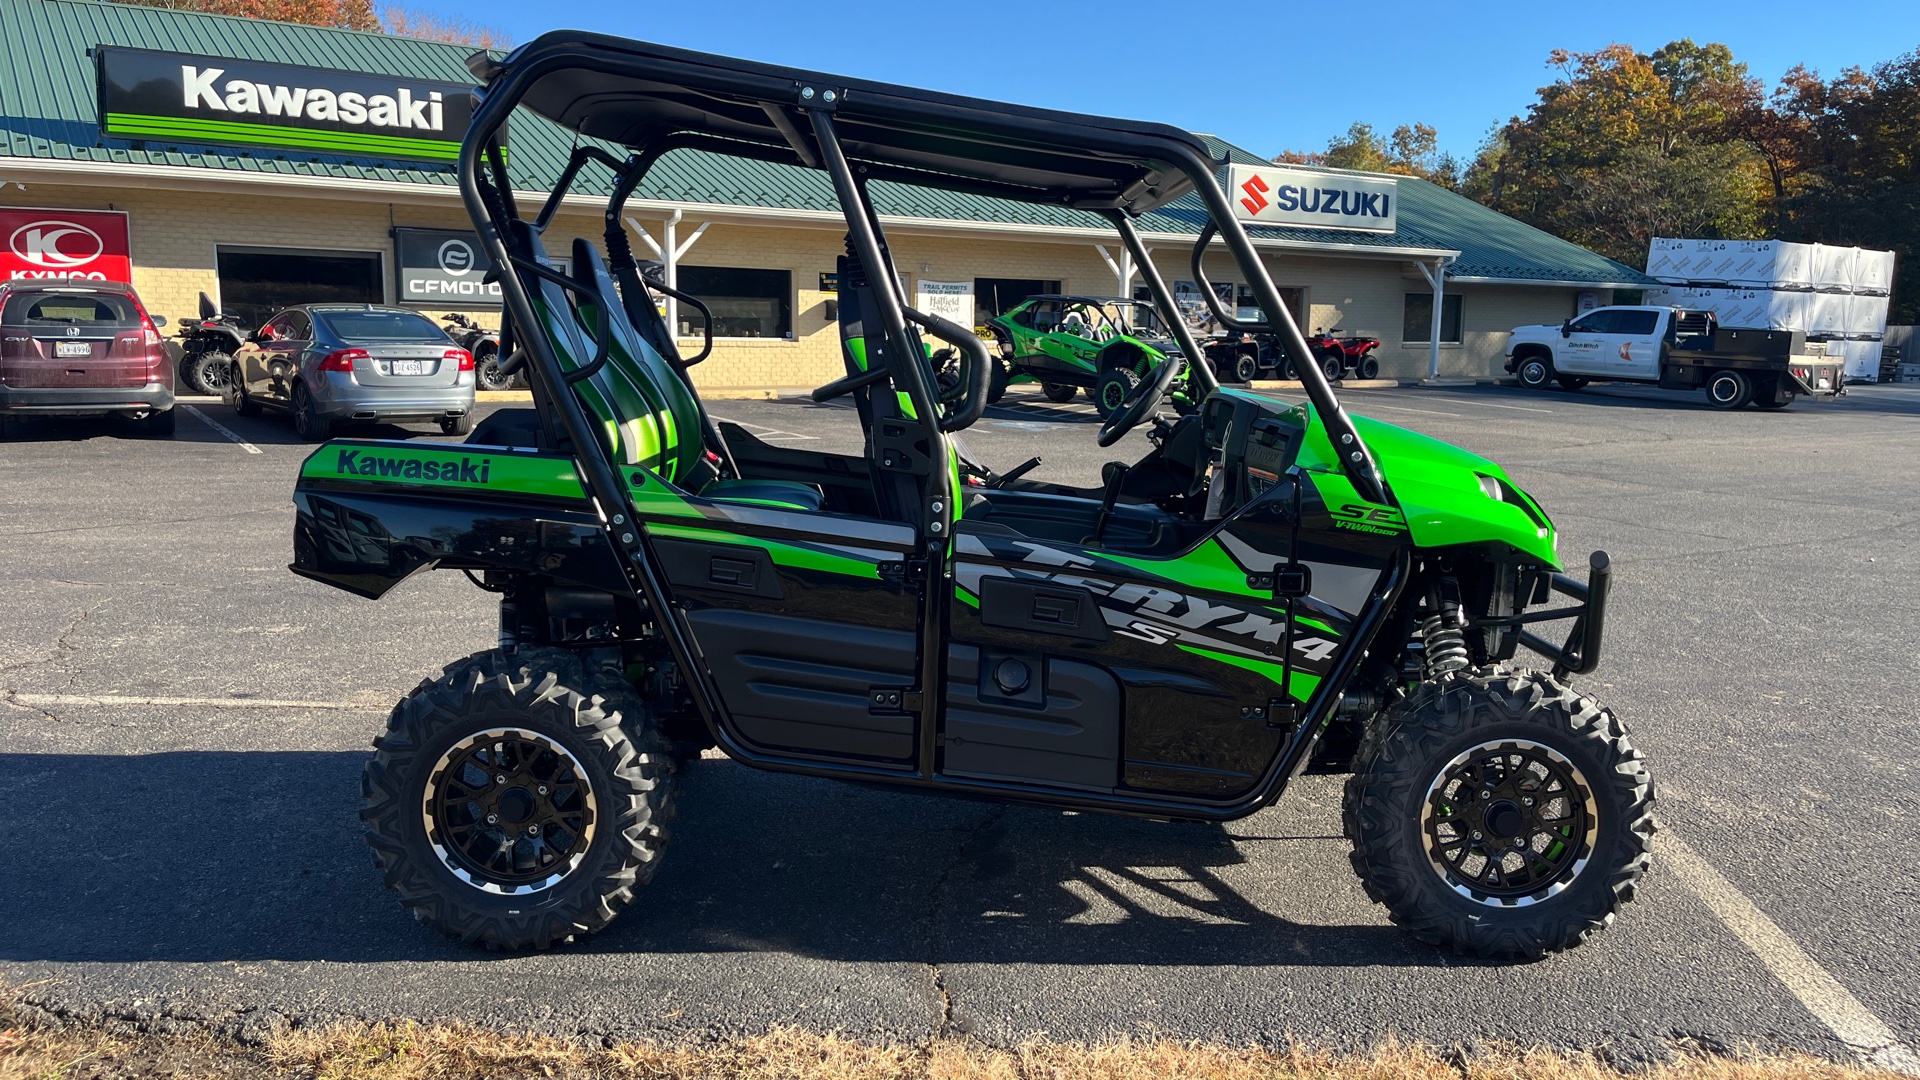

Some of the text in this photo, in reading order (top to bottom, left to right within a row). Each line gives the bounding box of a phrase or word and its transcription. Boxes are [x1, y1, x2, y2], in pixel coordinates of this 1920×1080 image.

[182, 65, 443, 131] Kawasaki
[1277, 184, 1390, 218] SUZUKI
[930, 296, 960, 308] Hatfield
[976, 330, 991, 338] PRO
[337, 449, 491, 484] Kawasaki
[1340, 504, 1398, 521] SE
[1113, 622, 1177, 645] S
